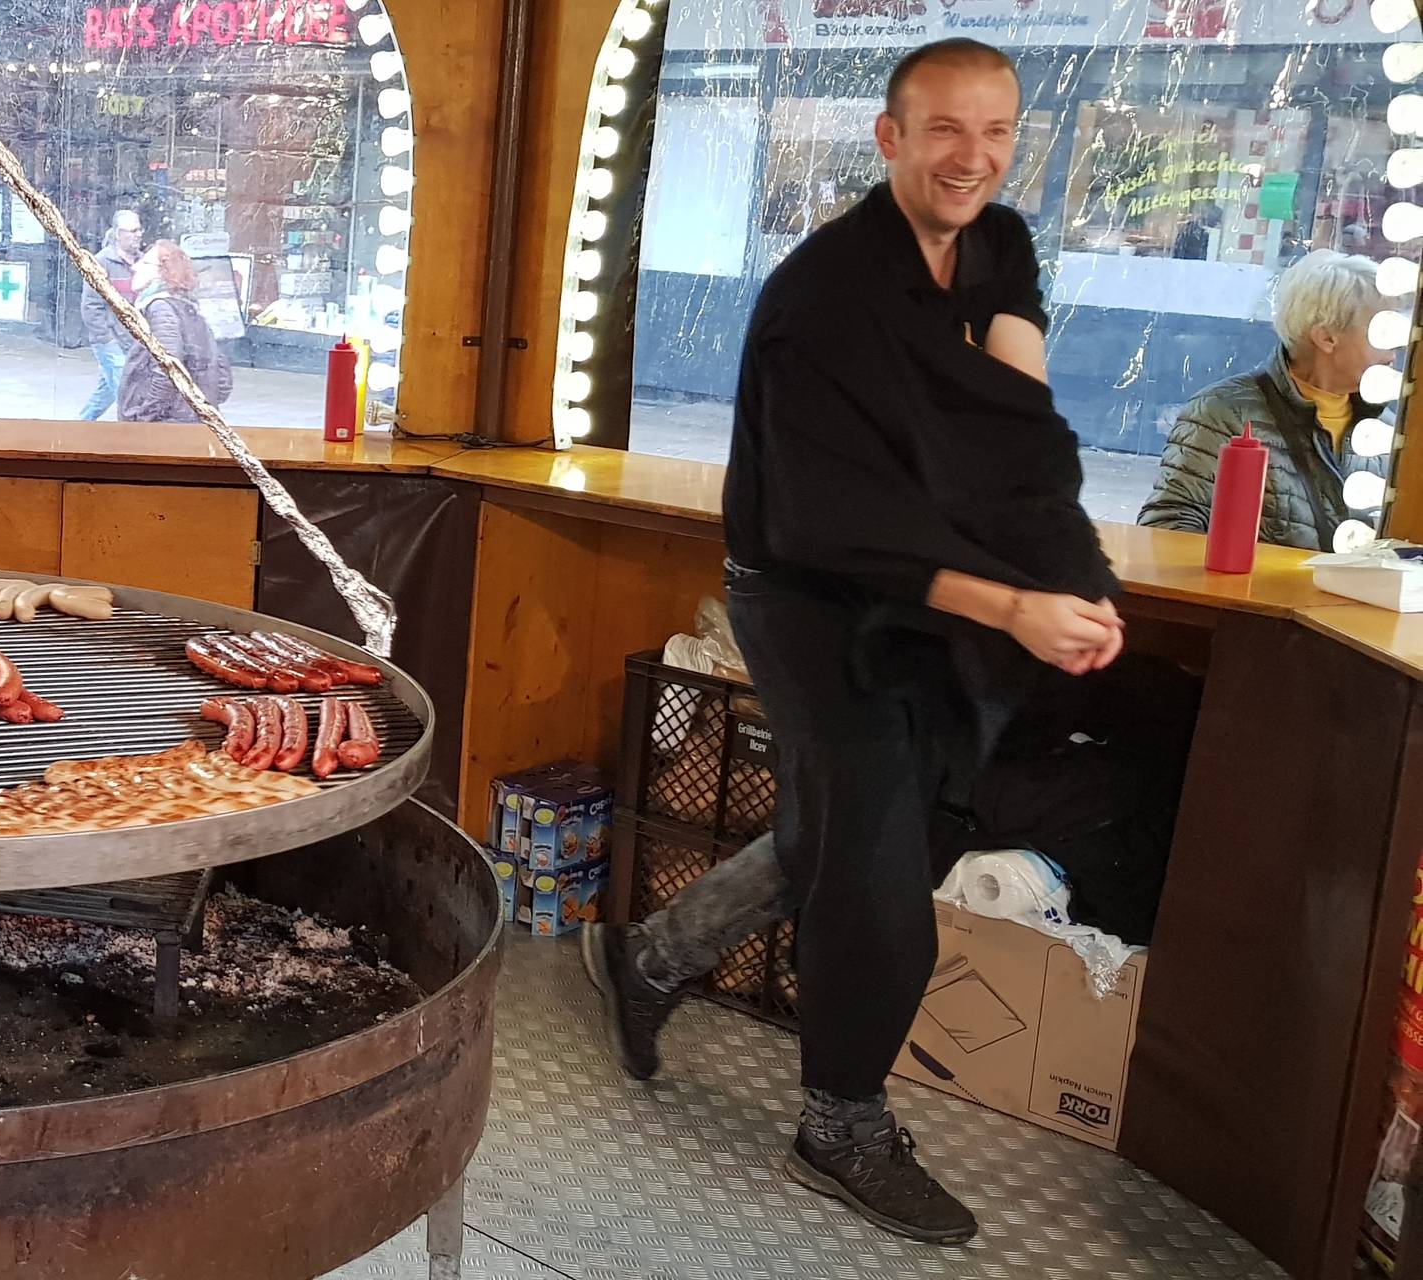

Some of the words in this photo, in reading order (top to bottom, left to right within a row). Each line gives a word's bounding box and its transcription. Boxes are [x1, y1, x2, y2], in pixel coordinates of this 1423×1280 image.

[1049, 1073, 1082, 1092] Napkin
[1083, 1085, 1113, 1102] Lunch
[1061, 1095, 1109, 1123] TORK
